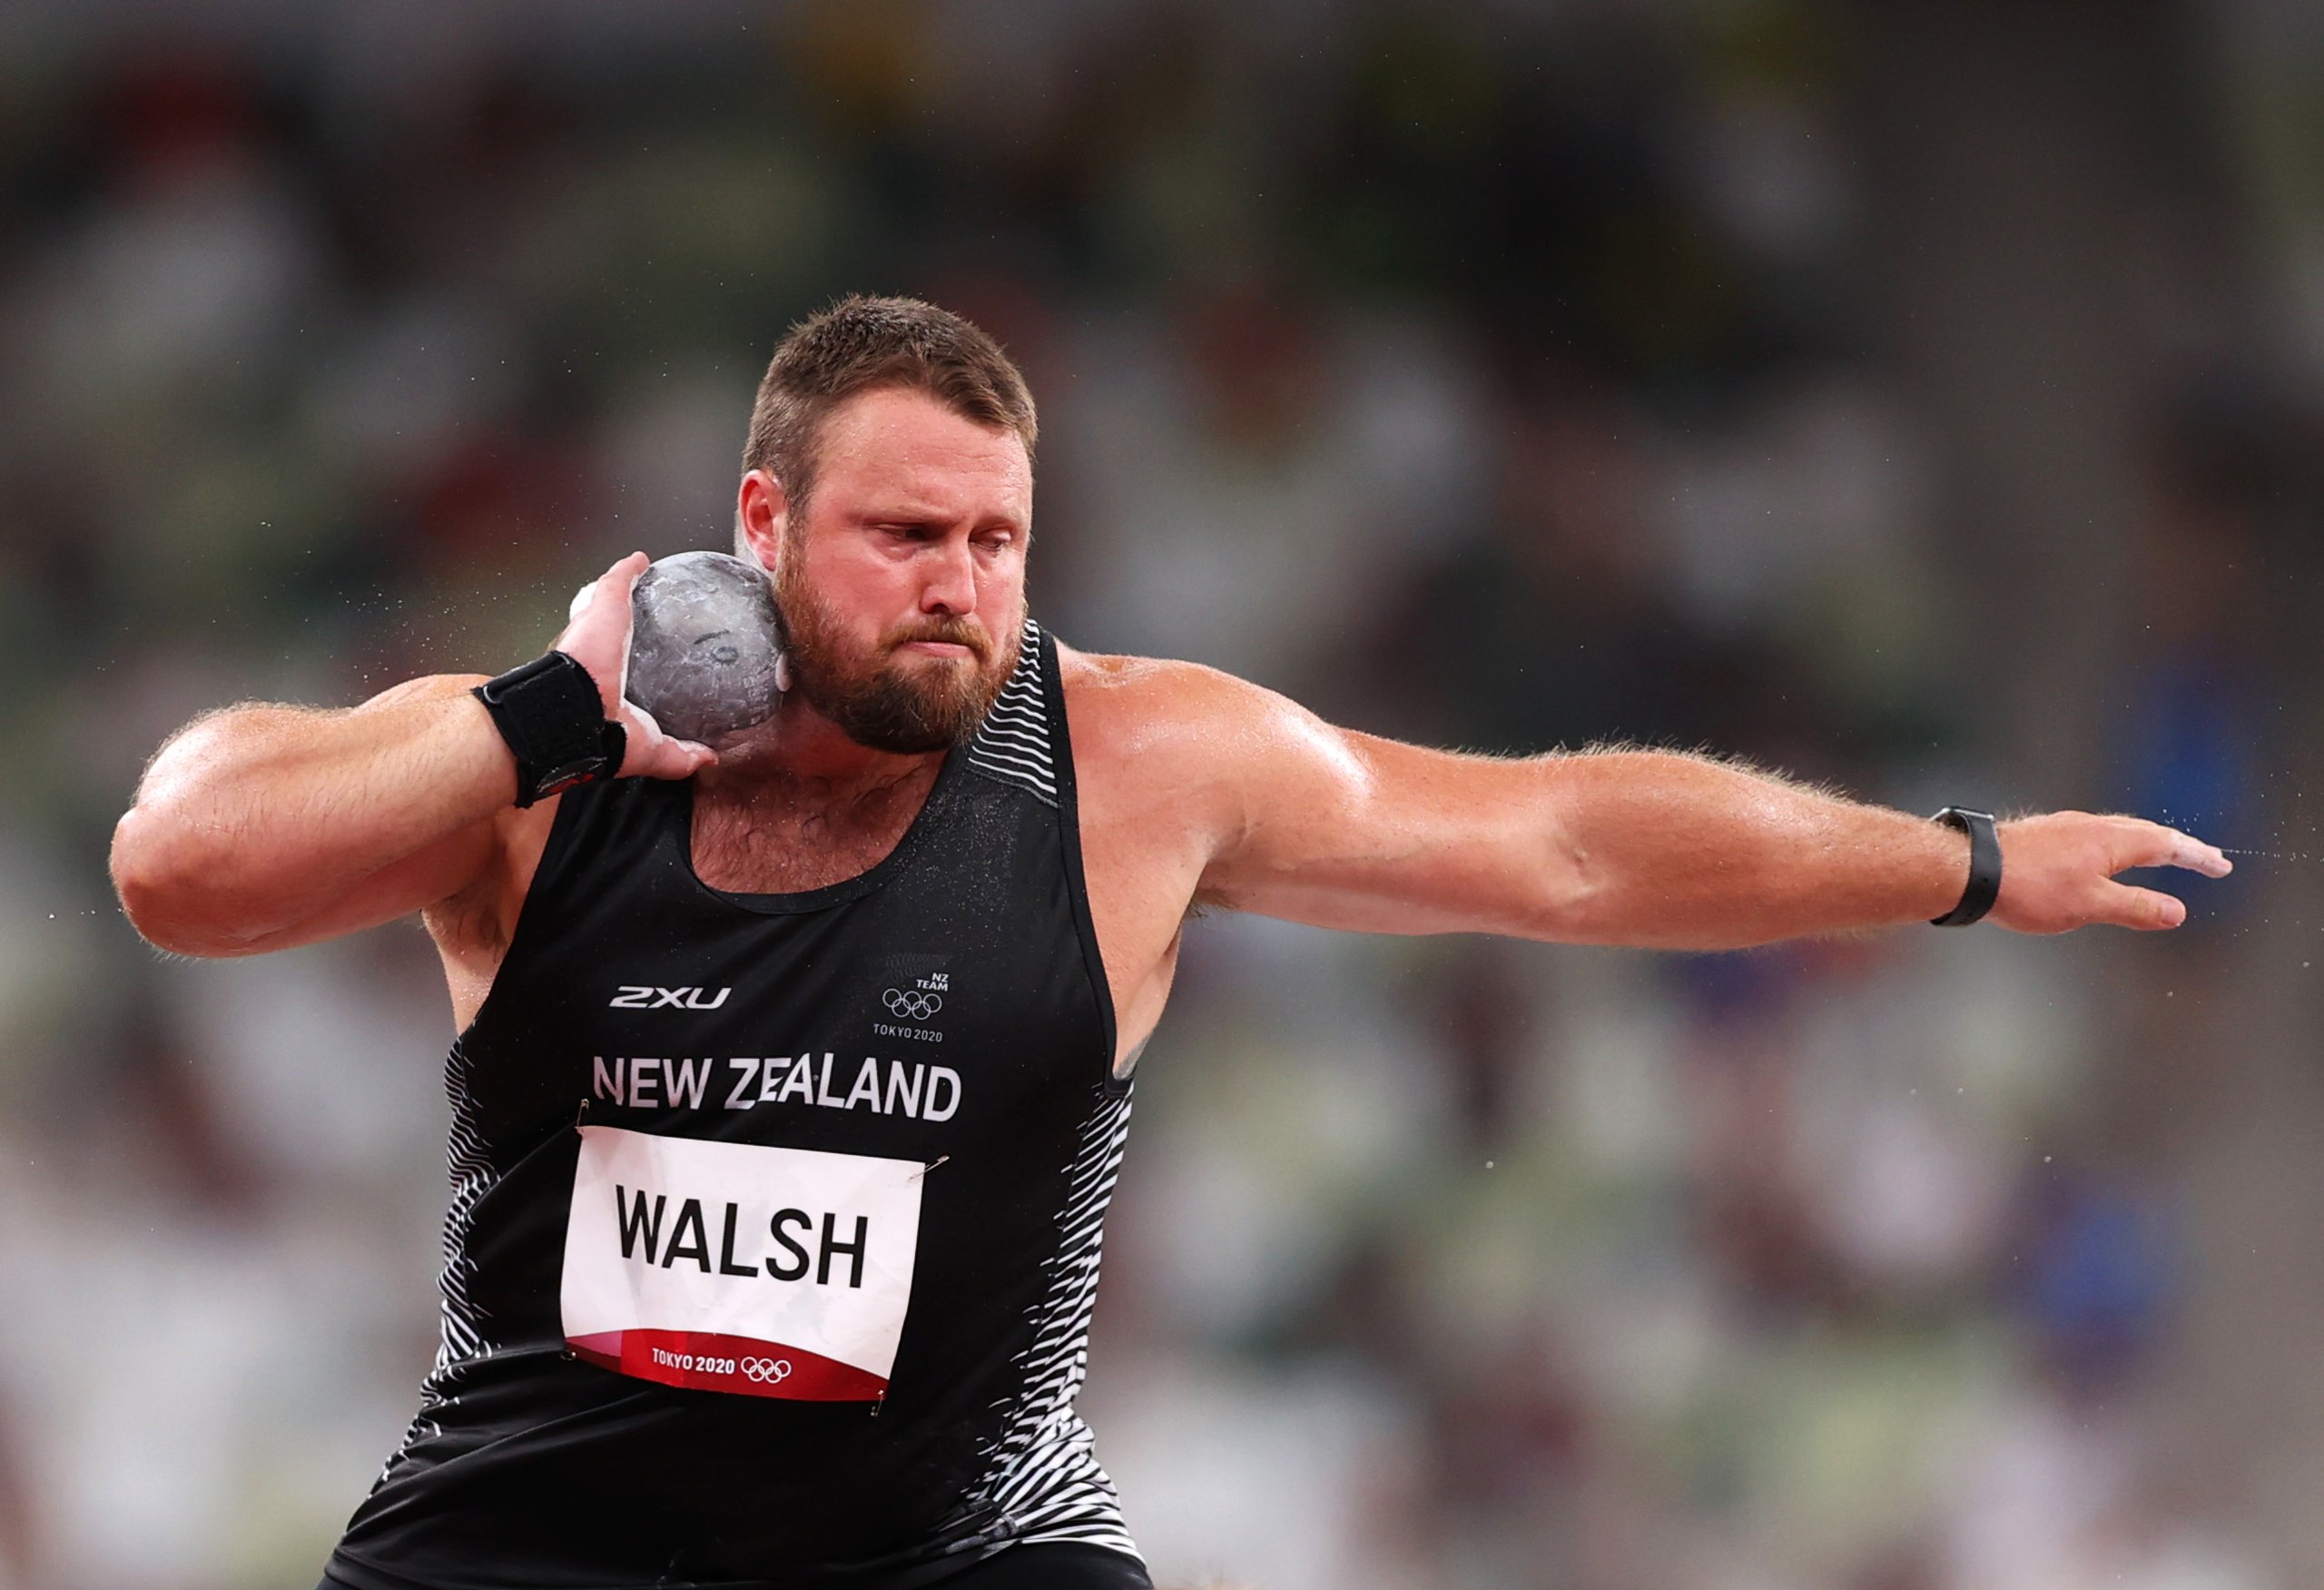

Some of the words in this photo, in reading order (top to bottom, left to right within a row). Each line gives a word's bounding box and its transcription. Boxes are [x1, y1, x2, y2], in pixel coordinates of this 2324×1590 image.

[916, 979, 949, 992] TEAM
[931, 973, 949, 983] NZ
[609, 986, 732, 1010] 2XU
[872, 1023, 911, 1039] TOKYO
[913, 1029, 943, 1042] 2020
[593, 1056, 713, 1110] NEW
[724, 1052, 962, 1122] ZEALAND
[615, 1184, 869, 1289] WALSH
[652, 1348, 693, 1371] TOKYO
[695, 1356, 735, 1375] 2020
